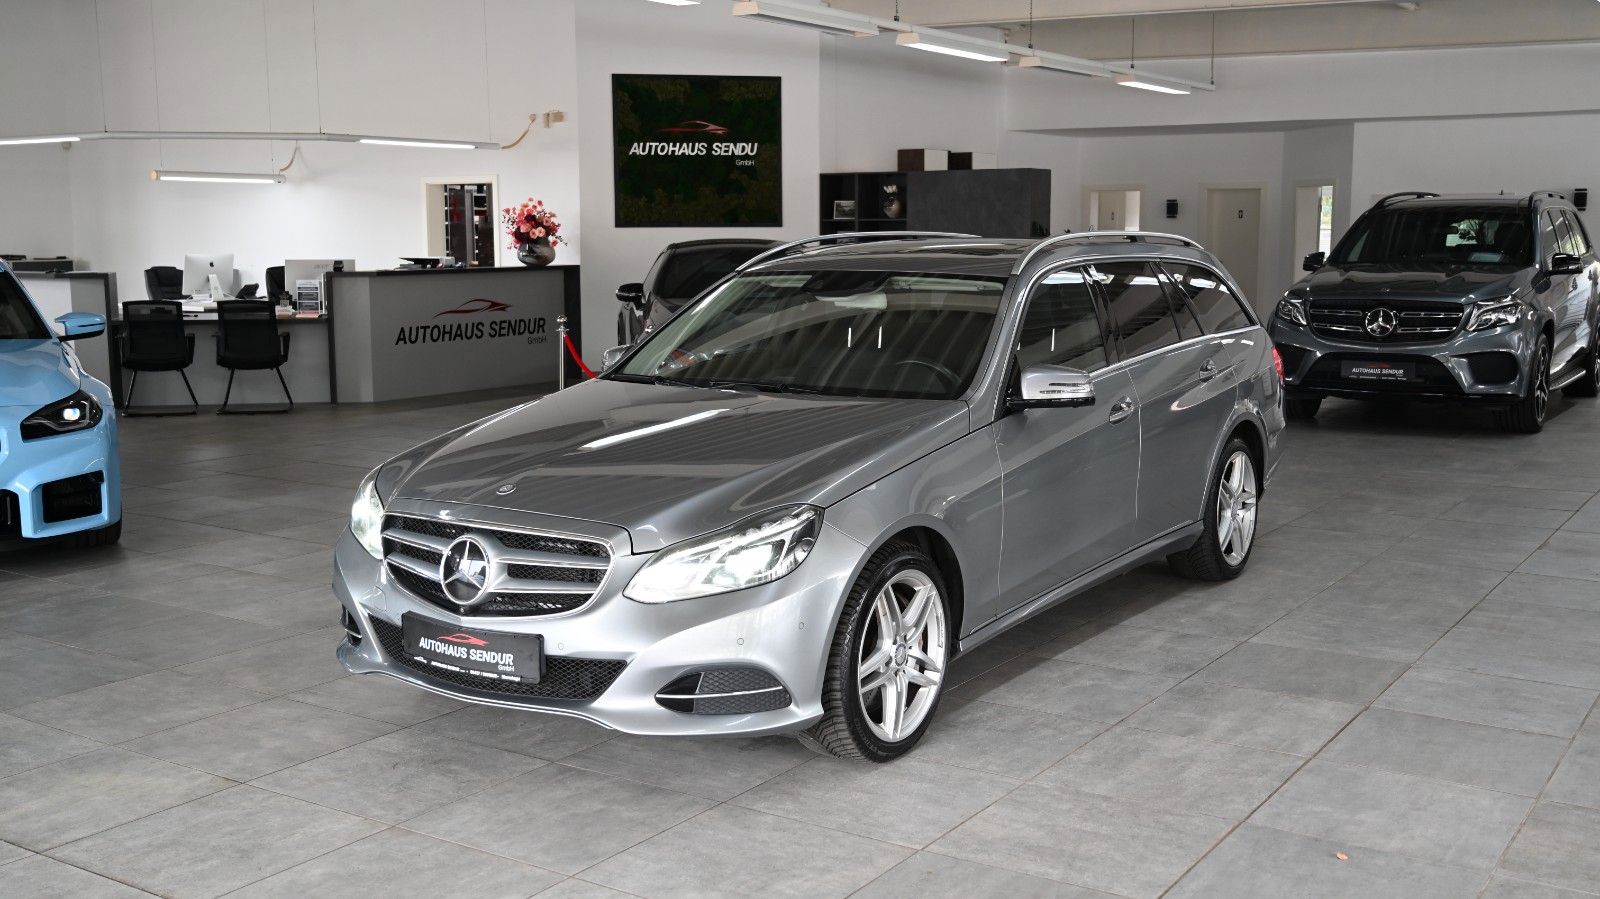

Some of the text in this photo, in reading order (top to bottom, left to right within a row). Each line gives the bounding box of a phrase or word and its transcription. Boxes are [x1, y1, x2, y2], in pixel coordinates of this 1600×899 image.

[629, 142, 758, 156] AUTOHAUS SENDU
[395, 317, 546, 346] AUTOHAUS SENDUR
[527, 336, 547, 345] GmbH
[419, 636, 514, 665] AUTOHAUS SENDUR
[497, 664, 515, 672] GmbH
